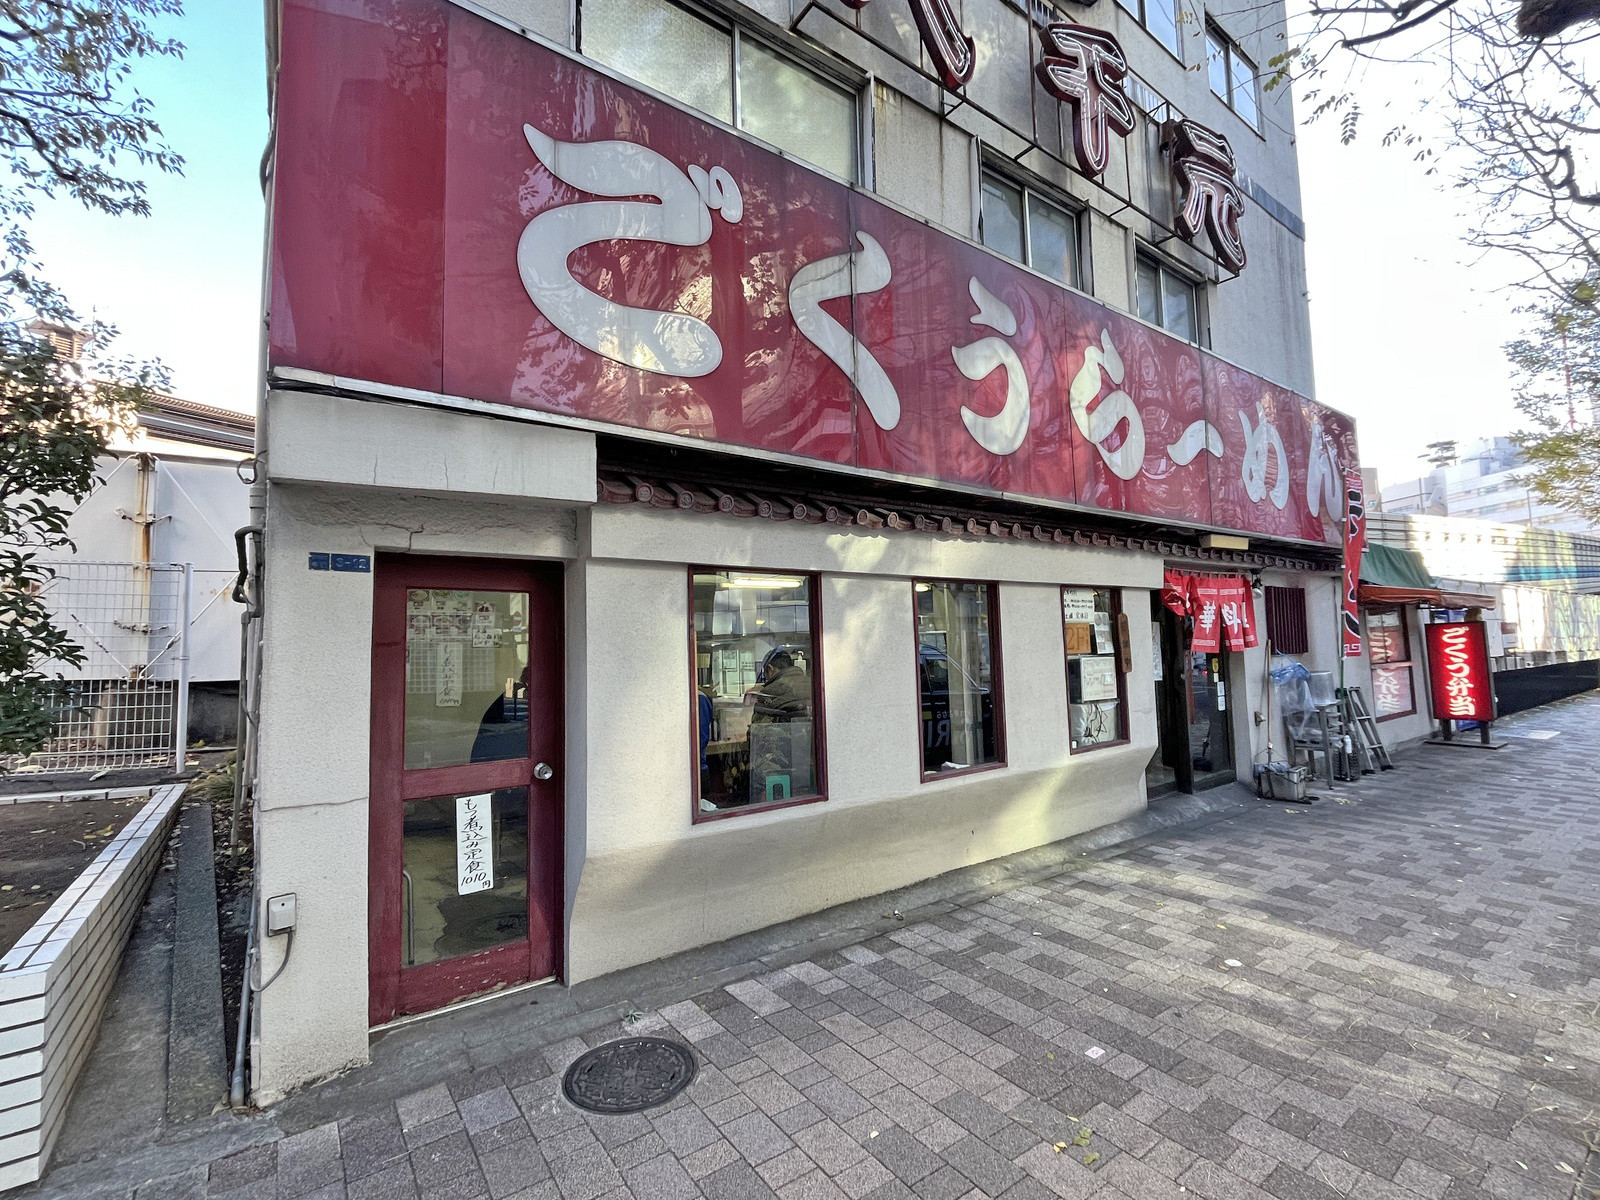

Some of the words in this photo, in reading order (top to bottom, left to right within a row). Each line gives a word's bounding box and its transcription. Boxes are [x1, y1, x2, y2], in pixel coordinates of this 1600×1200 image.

[1441, 625, 1476, 716] ごくう弁当
[461, 798, 488, 874] もつ煮込み定食
